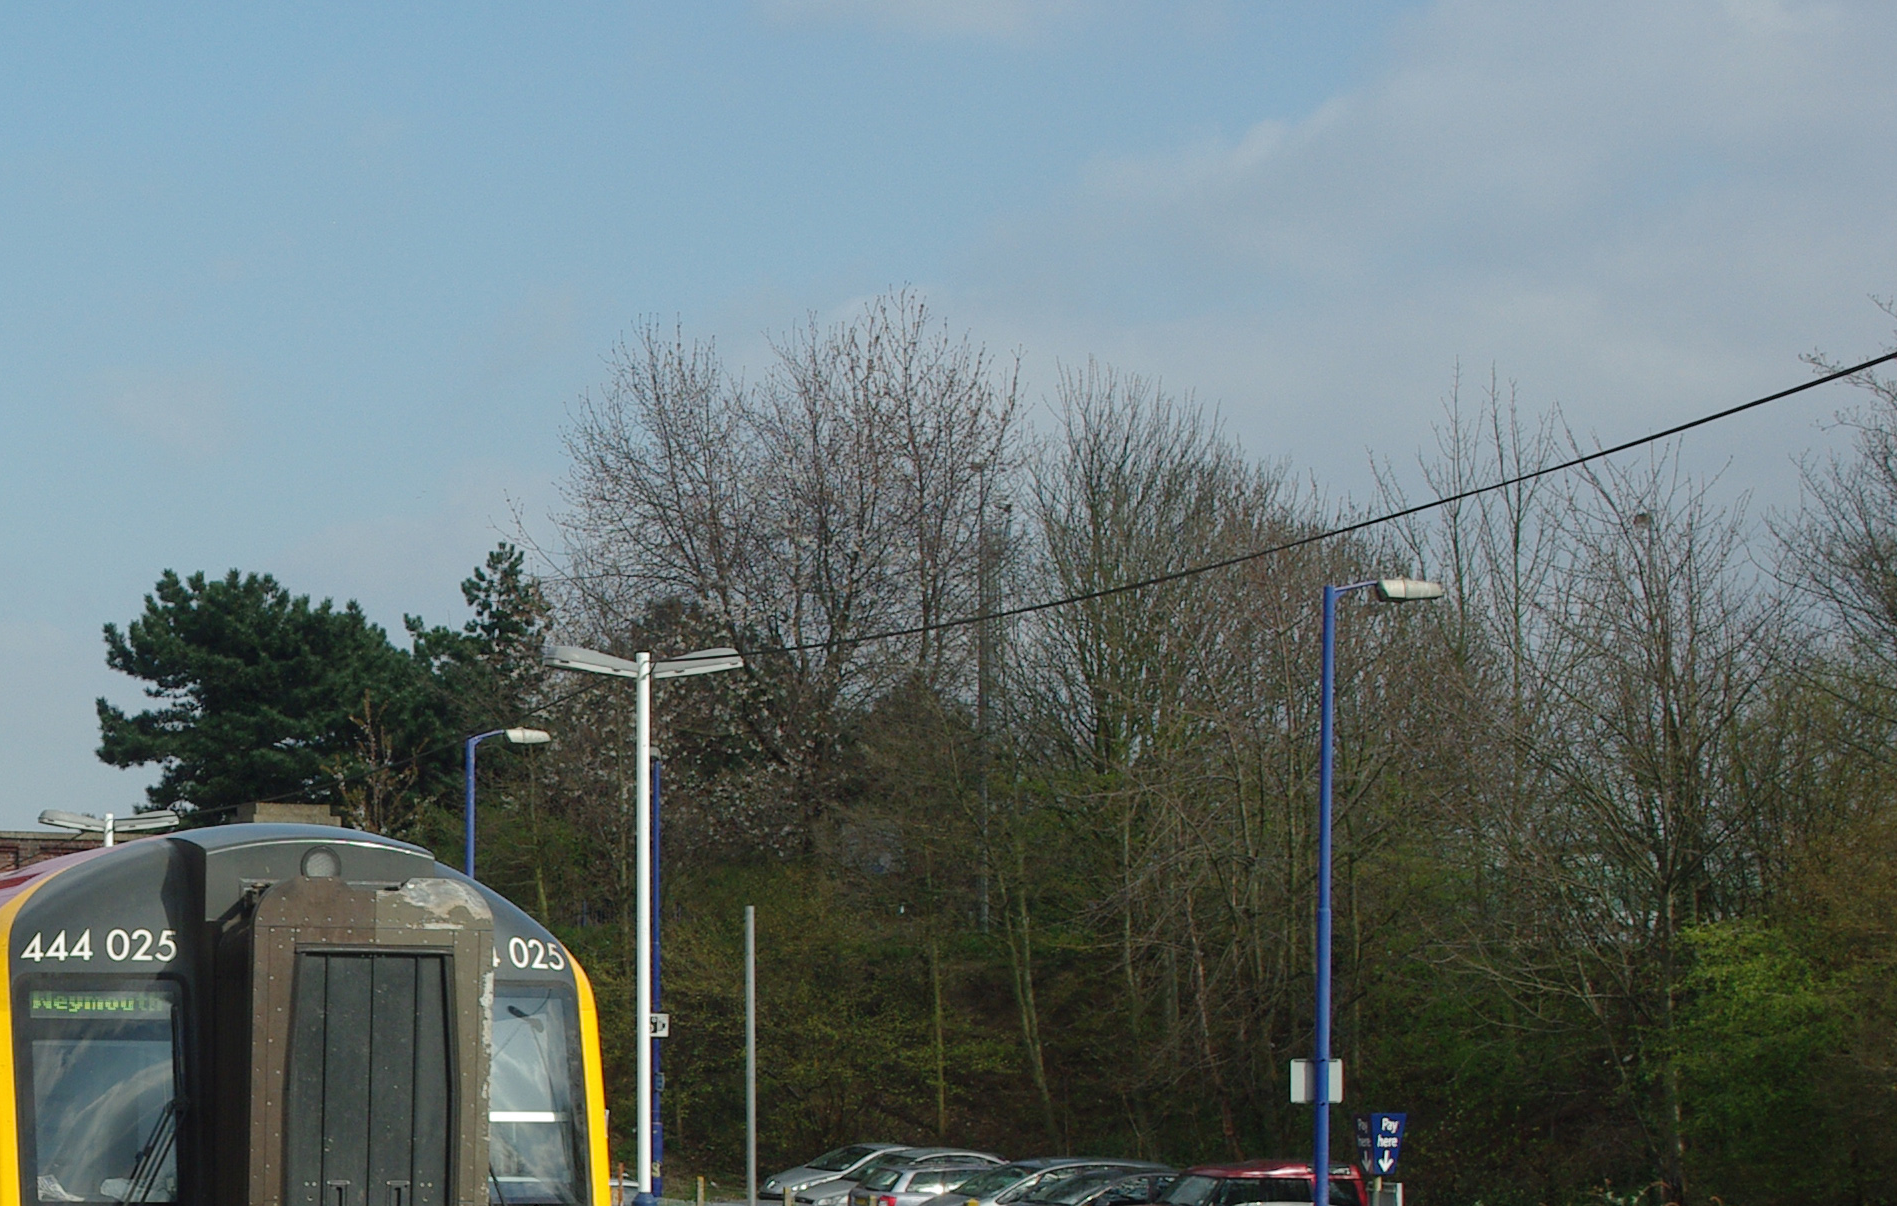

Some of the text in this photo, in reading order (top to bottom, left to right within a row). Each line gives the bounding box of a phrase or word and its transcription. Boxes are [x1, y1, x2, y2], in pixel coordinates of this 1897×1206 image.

[20, 928, 178, 962] 444 025
[508, 936, 565, 971] 025
[1382, 1117, 1399, 1134] Pay
[1377, 1133, 1398, 1148] here
